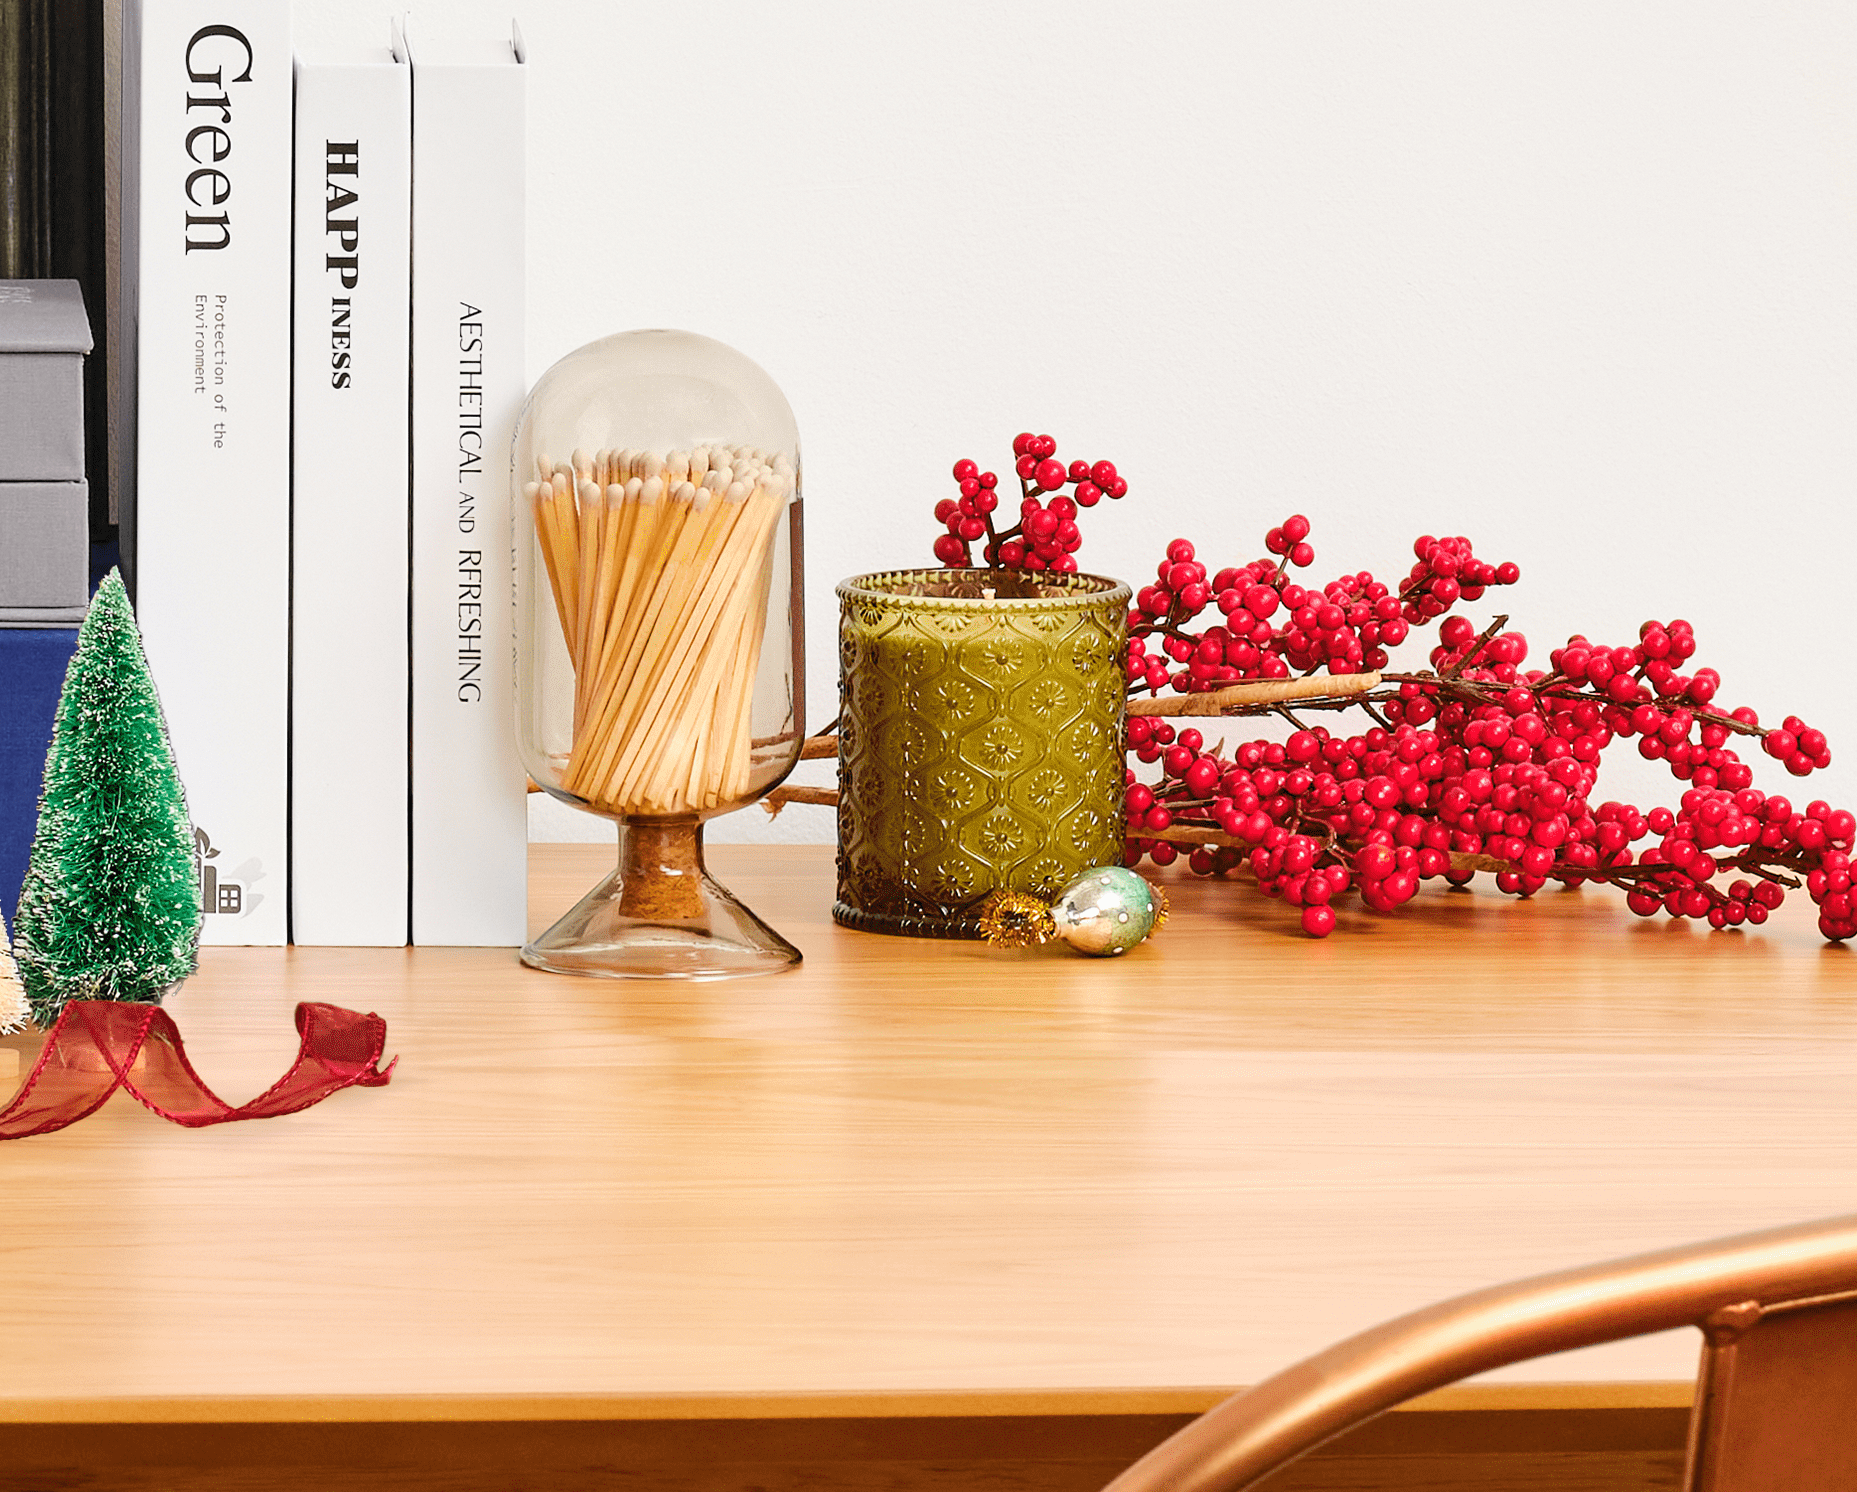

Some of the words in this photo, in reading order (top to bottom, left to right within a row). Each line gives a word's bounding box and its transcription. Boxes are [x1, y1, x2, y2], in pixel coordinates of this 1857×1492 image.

[184, 23, 254, 256] Green
[195, 294, 208, 394] Environment
[214, 294, 228, 385] Protection
[213, 422, 227, 449] the
[214, 394, 227, 413] of
[458, 301, 483, 483] AESTHETICAL
[458, 491, 475, 534] AND
